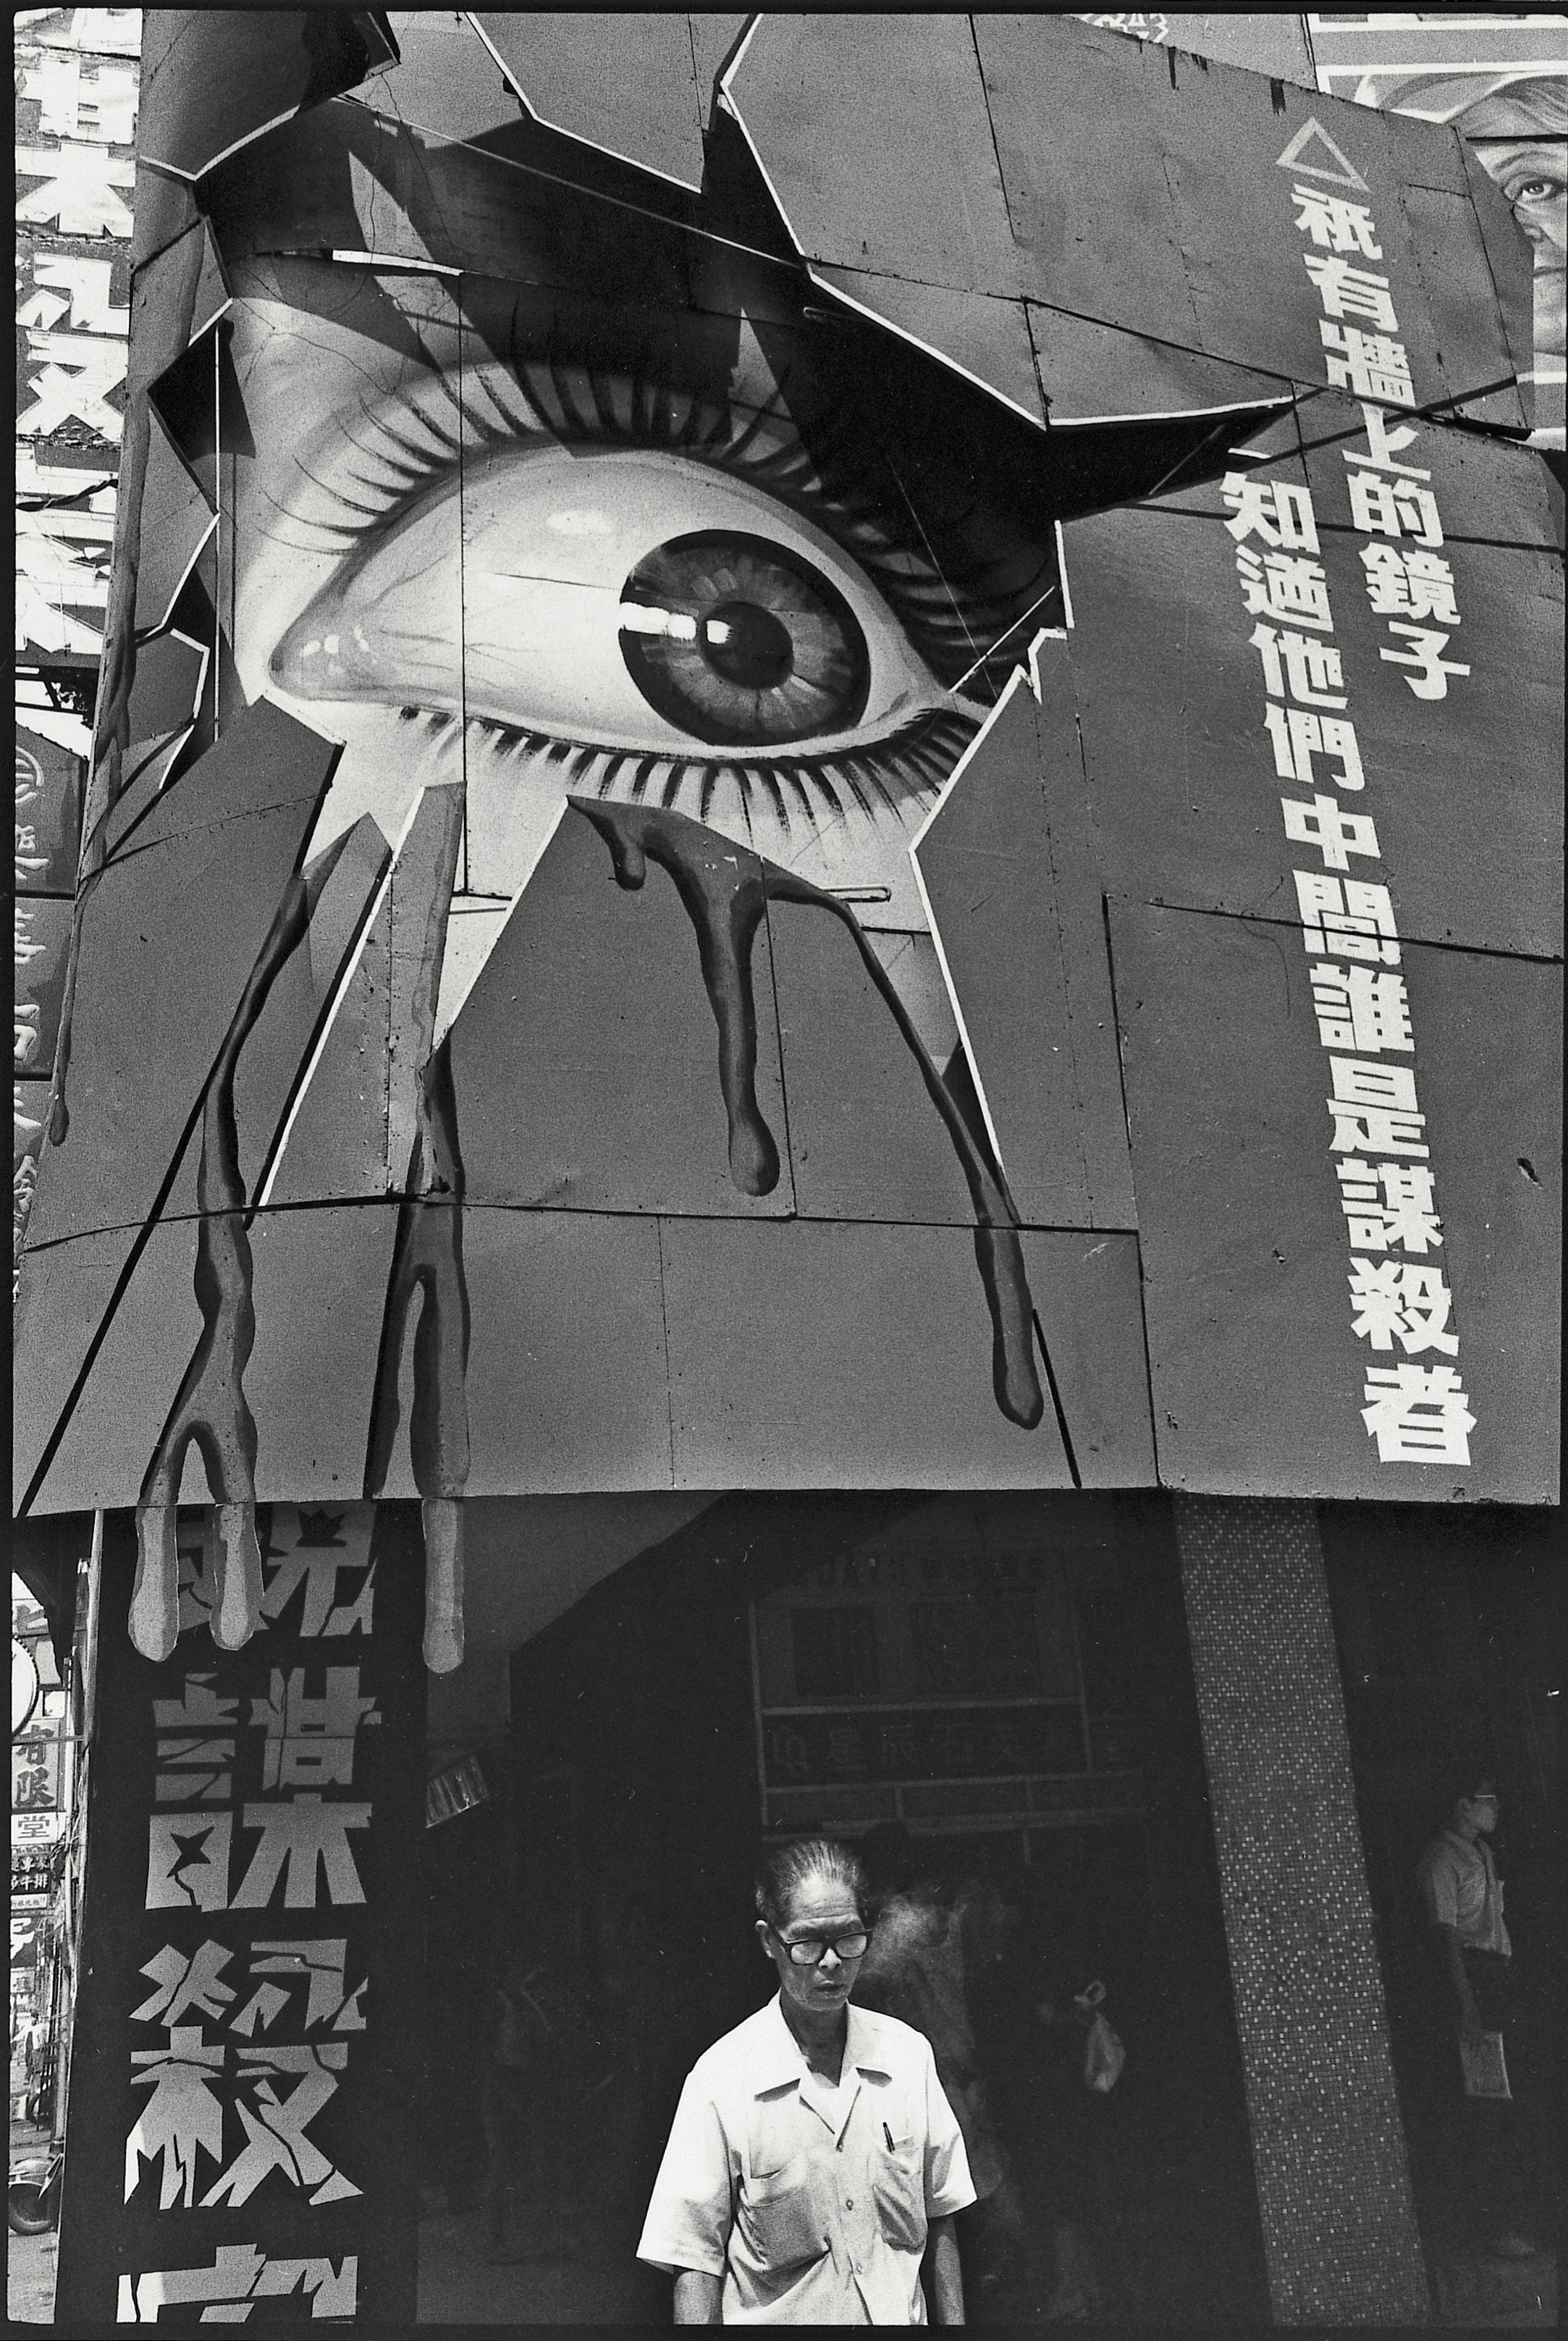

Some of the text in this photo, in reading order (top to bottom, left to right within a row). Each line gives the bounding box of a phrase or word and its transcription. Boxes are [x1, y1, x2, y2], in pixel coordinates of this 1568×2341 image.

[1220, 471, 1477, 1466] 知道他們中間誰是謀殺者
[17, 1815, 50, 1838] 堂
